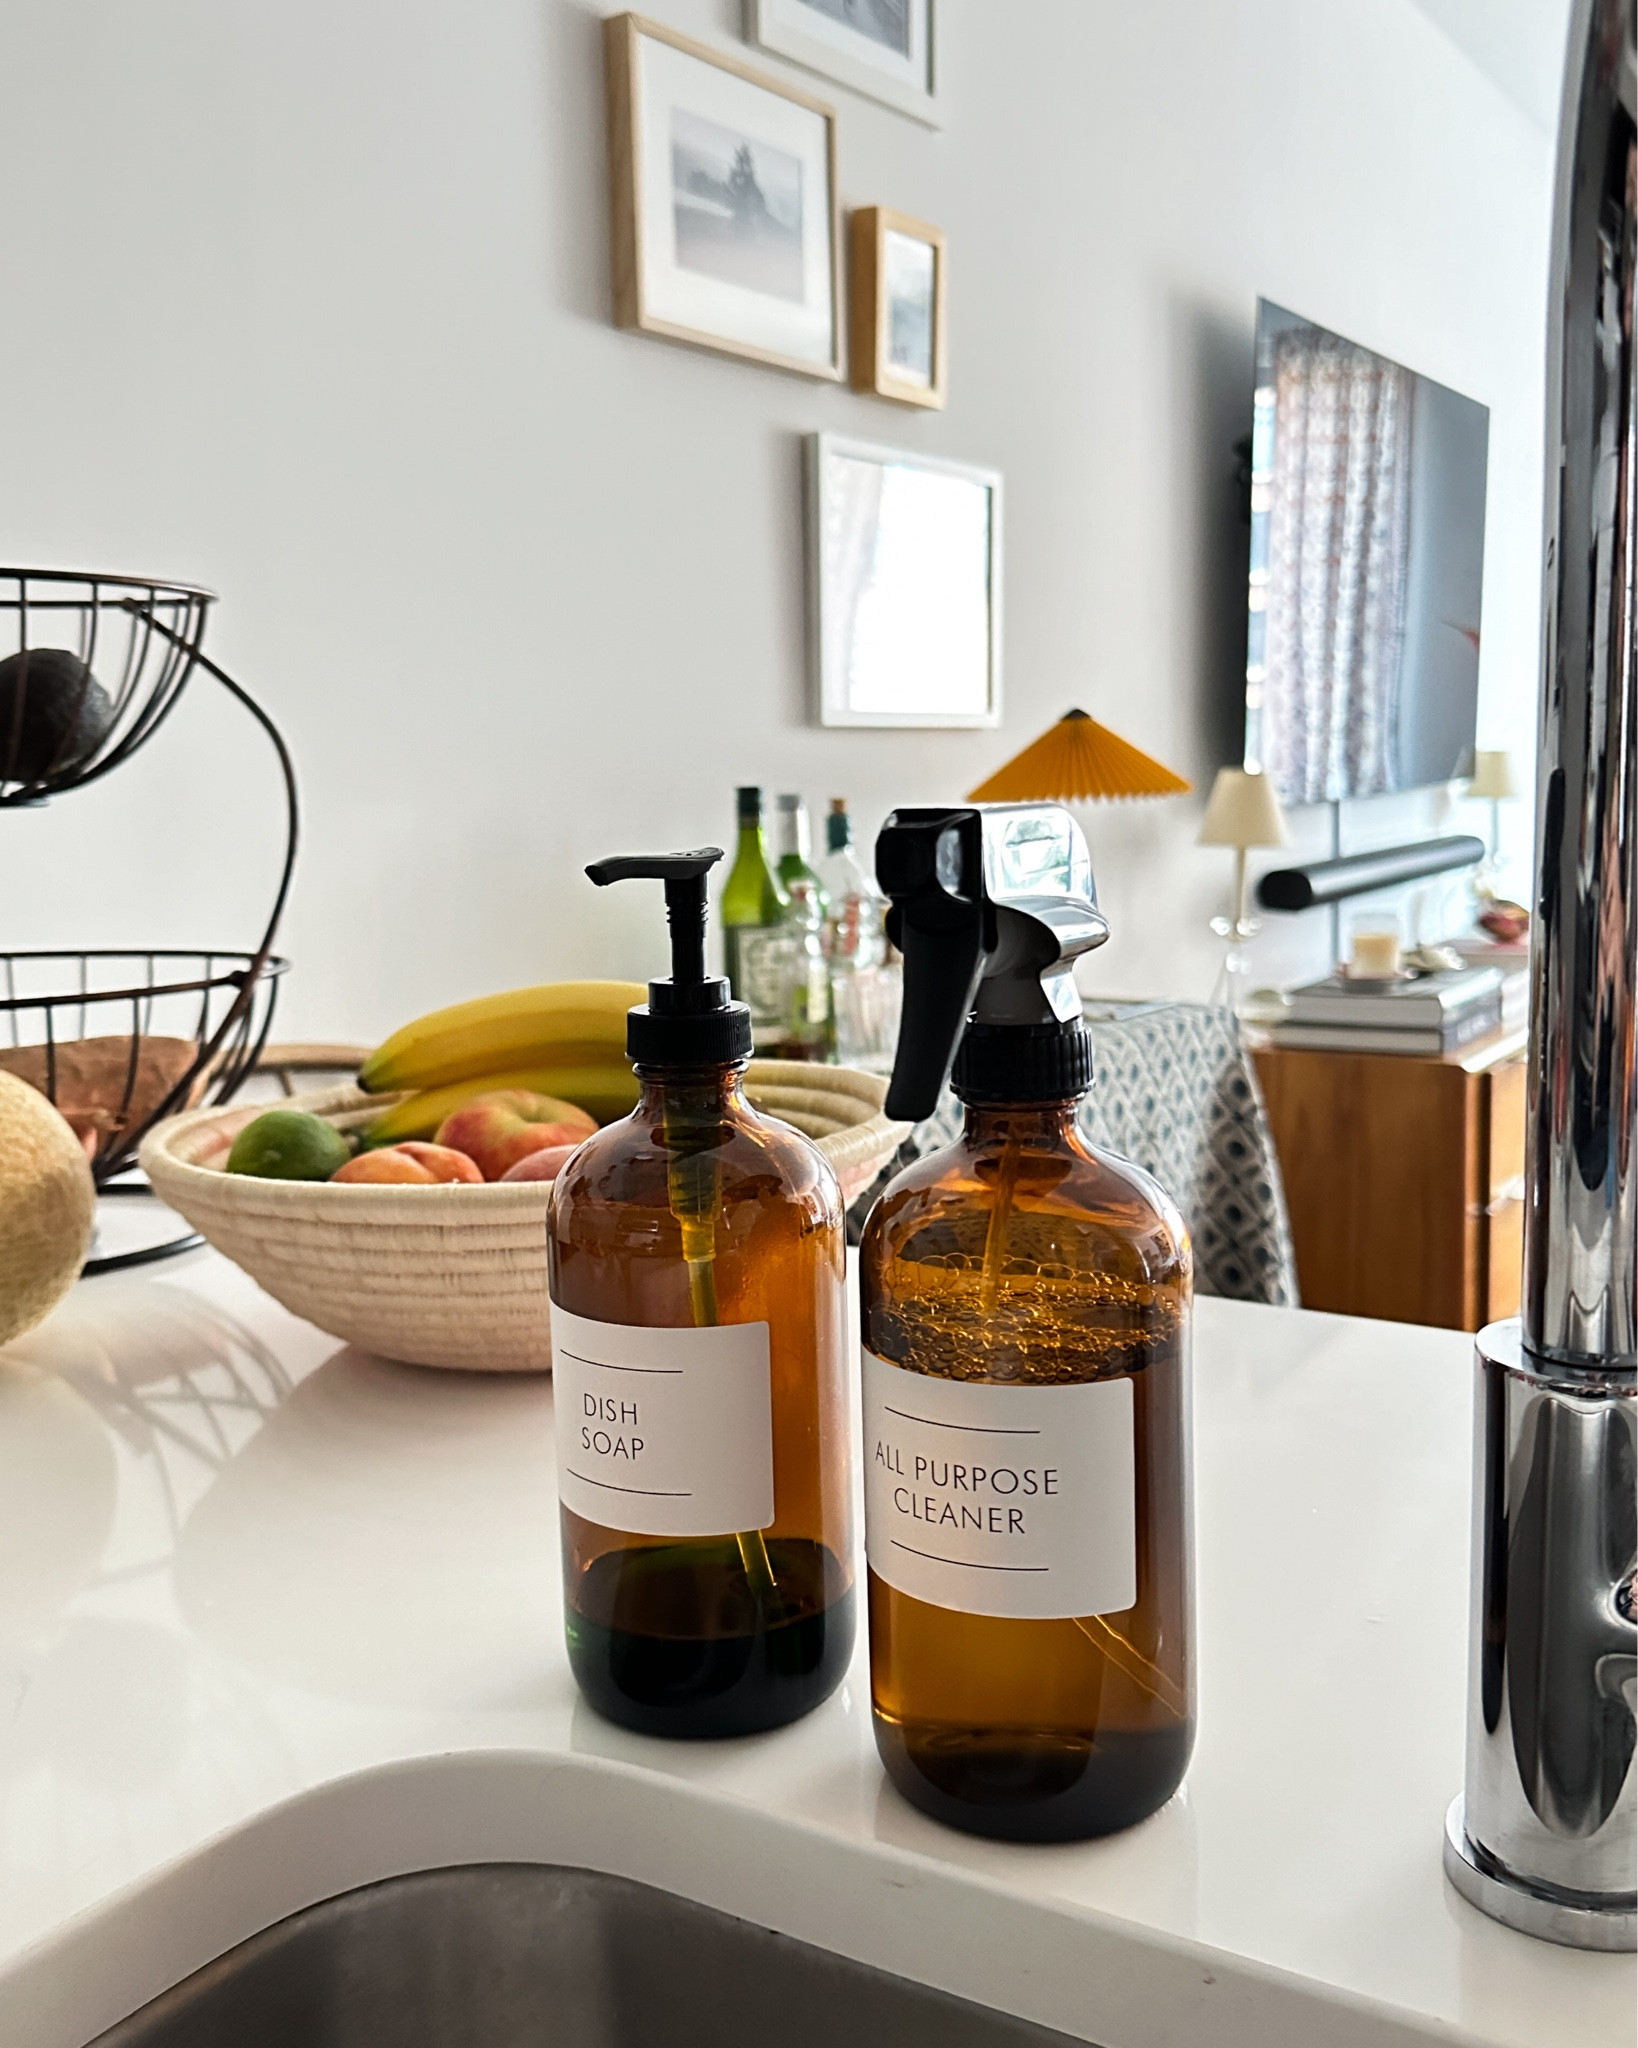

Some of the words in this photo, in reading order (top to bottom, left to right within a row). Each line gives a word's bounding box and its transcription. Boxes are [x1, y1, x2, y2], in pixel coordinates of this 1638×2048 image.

[583, 1393, 637, 1425] DISH
[581, 1427, 644, 1460] SOAP
[875, 1440, 905, 1476] ALL
[915, 1456, 1058, 1495] PURPOSE
[894, 1487, 1025, 1534] CLEANER
